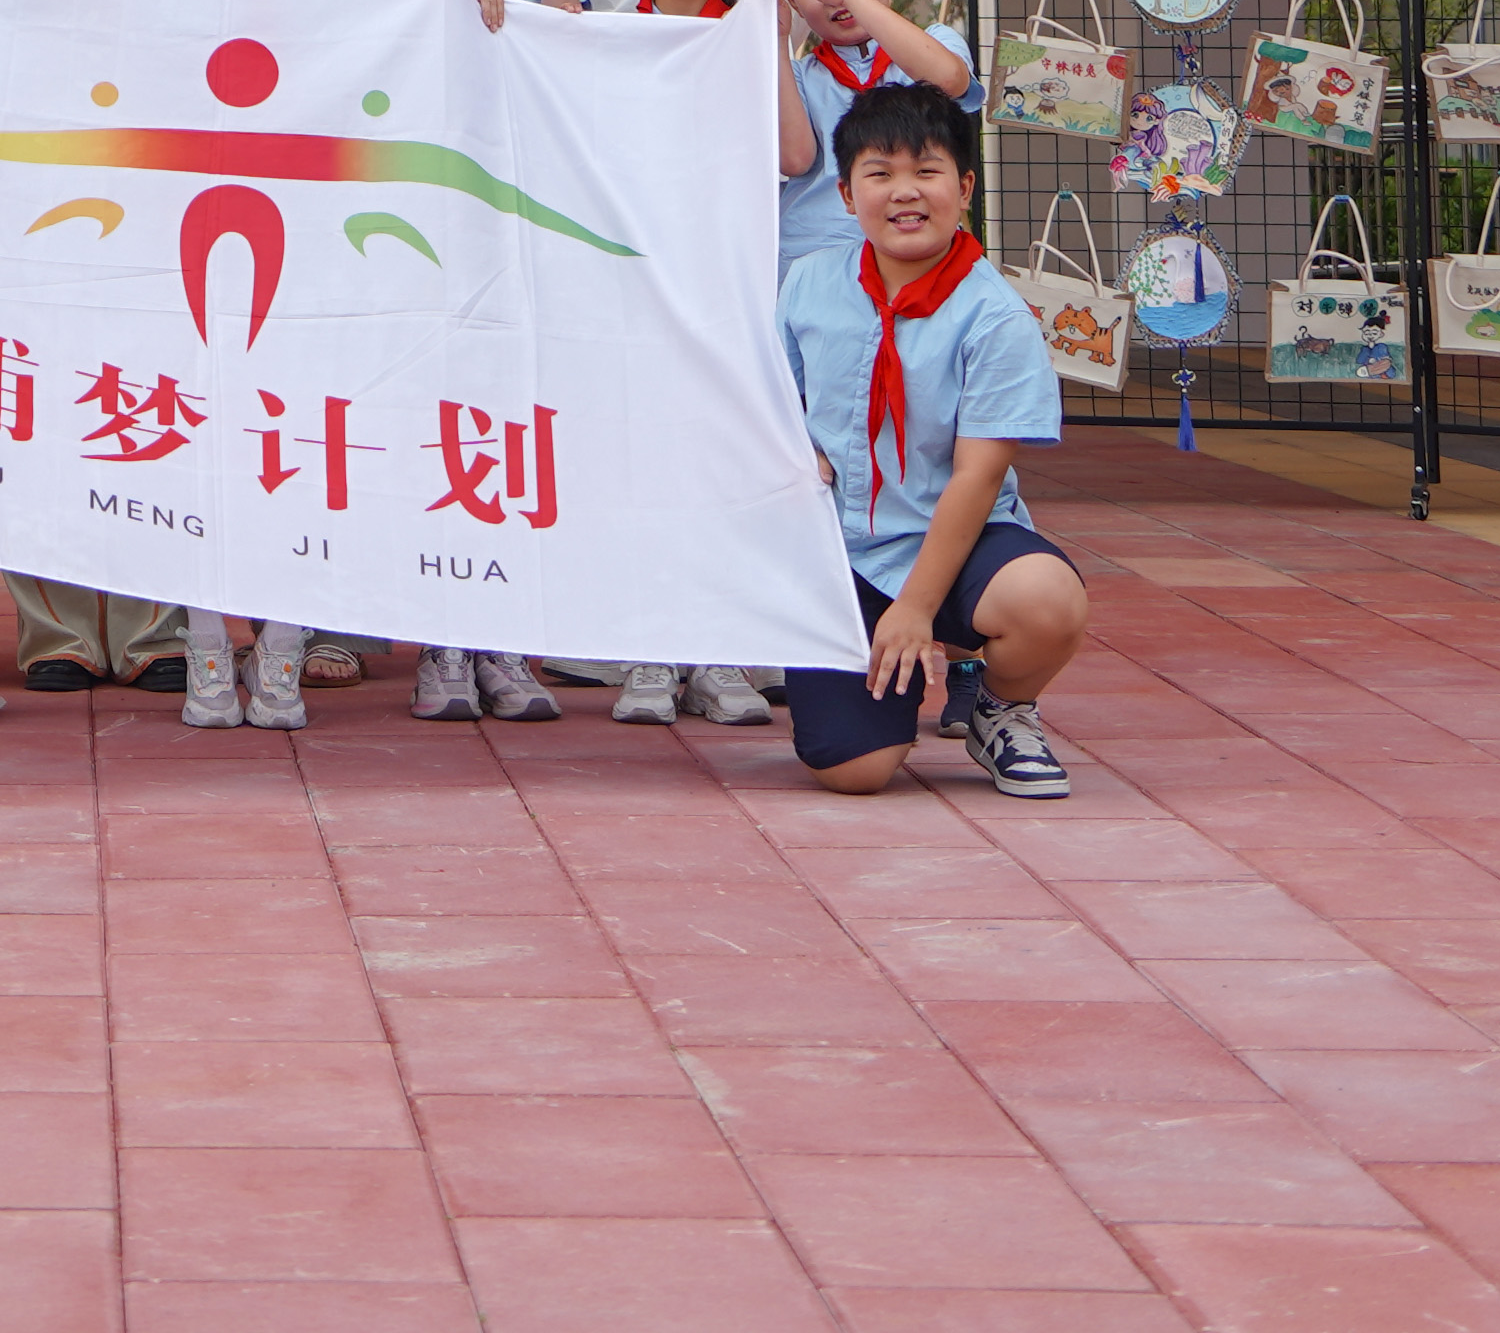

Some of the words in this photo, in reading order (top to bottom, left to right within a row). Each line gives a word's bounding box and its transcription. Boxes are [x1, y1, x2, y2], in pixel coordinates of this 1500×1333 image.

[90, 490, 204, 538] MENG
[293, 535, 331, 561] JI
[420, 552, 508, 584] HUA
